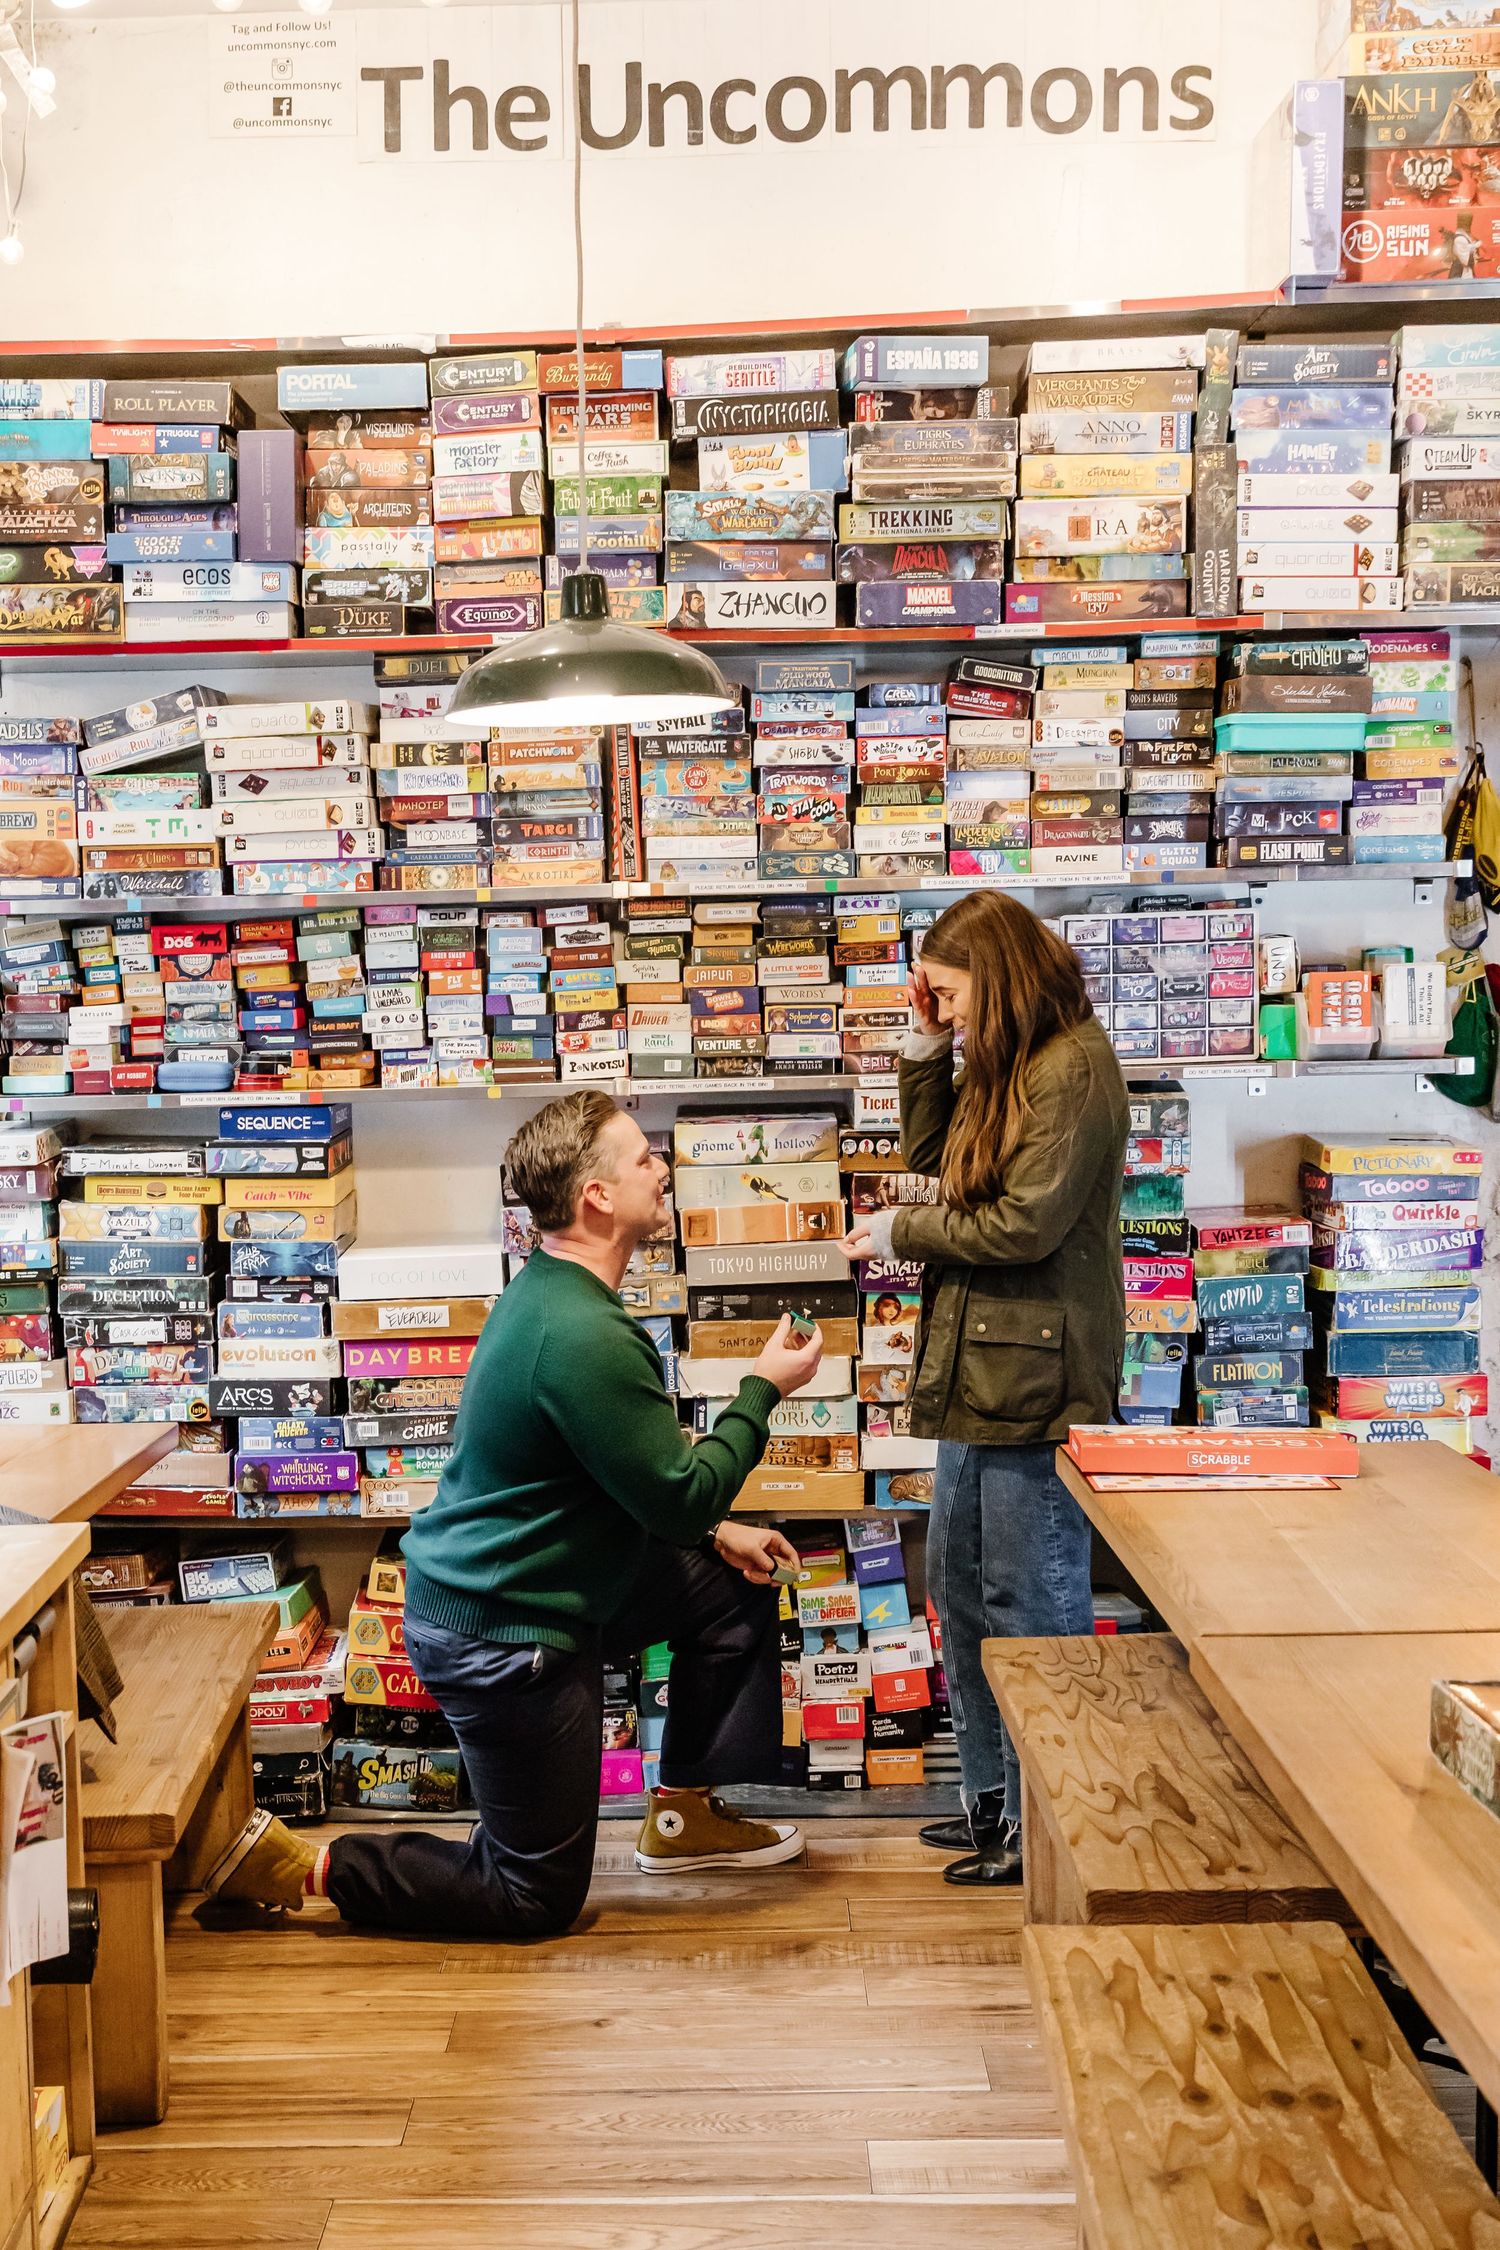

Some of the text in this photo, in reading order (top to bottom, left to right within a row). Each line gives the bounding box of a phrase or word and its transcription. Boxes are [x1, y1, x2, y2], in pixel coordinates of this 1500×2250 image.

[232, 21, 331, 35] Tag and Follow Us!
[228, 38, 337, 52] uncommonsnyc.com
[223, 80, 342, 93] @theuncommonsnyc
[360, 58, 1214, 153] The Uncommons
[1351, 83, 1436, 114] ANKH
[233, 117, 332, 129] @uncommonsnyc
[1403, 156, 1452, 176] blood
[1408, 174, 1448, 191] rage
[1387, 224, 1429, 238] RISING
[1387, 240, 1429, 257] SUN
[886, 347, 979, 370] ESPAÑA 1936
[1306, 347, 1330, 364] ART
[728, 363, 772, 371] REBUILDING
[1294, 362, 1339, 382] SOCIETY
[287, 374, 357, 390] PORTAL
[445, 364, 512, 386] CENTURY
[725, 371, 777, 388] SEATTLE
[1036, 378, 1119, 393] MERCHANTS
[114, 398, 218, 412] ROLL PLAYER
[1047, 391, 1135, 408] MARAUDERS
[457, 399, 515, 421] CENTURY
[112, 428, 199, 438] TWILIGHT STRUGGLE
[365, 423, 414, 435] VISCOUNTS
[1082, 420, 1141, 433] ANNO
[917, 429, 952, 441] TIGRIS
[1094, 435, 1129, 444] 1800
[450, 442, 501, 457] monster
[728, 443, 776, 460] Funny
[904, 439, 964, 451] EUPHRATES
[588, 452, 612, 461] Coffee
[1287, 444, 1337, 461] HAMLET
[1425, 444, 1477, 471] STEAM UP
[358, 461, 407, 475] PALADINS
[454, 453, 498, 469] factory
[607, 456, 628, 467] Rush
[733, 454, 783, 472] Bunny
[363, 503, 411, 516] ARCHITECTS
[869, 508, 953, 527] TREKKING
[341, 541, 398, 553] passtally
[183, 568, 231, 585] ecos
[1205, 550, 1215, 604] COUNTY
[1218, 549, 1229, 606] HARROW
[907, 587, 952, 604] MARVEL
[717, 591, 827, 618] ZHANGUO
[902, 606, 956, 615] CHAMPIONS
[337, 609, 390, 627] DUKE
[463, 608, 516, 621] Equinox
[408, 661, 447, 674] DUEL
[974, 665, 1023, 682] GOODCRITTERS
[775, 679, 835, 689] MANCALA
[951, 693, 1008, 709] RESISTANCE
[971, 691, 991, 699] THE
[768, 701, 836, 713] SKY TEAM
[657, 714, 706, 731] SPYFALL
[1158, 717, 1179, 731] CITY
[1056, 726, 1105, 739] DECRYPTO
[509, 745, 574, 757] PATCHWORK
[667, 740, 727, 754] WATERGATE
[874, 766, 930, 779] PORT ROYAL
[767, 773, 826, 788] TRAPWORDS
[398, 800, 444, 812] IMHOTEP
[792, 800, 815, 818] STAY
[809, 802, 837, 820] COOL
[521, 823, 573, 837] TARGI
[529, 846, 570, 857] CORINTH
[1160, 847, 1199, 856] GLITCH
[1260, 841, 1325, 862] FLASH POINT
[1360, 845, 1409, 855] CODENAMES
[1055, 853, 1098, 863] RAVINE
[1162, 856, 1196, 865] SQUAD
[521, 870, 575, 881] AKROTIRI
[851, 900, 882, 909] CAT
[429, 911, 467, 921] COUP
[1271, 946, 1287, 982] UNO
[693, 970, 733, 983] JAIPUR
[780, 989, 826, 999] WORDSY
[312, 1022, 359, 1031] SOLAR DRAFT
[697, 1040, 741, 1051] VENTURE
[237, 1116, 311, 1130] SEQUENCE
[692, 1138, 816, 1157] gnome hollow
[1353, 1156, 1433, 1172] PICTIONARY
[1359, 1178, 1430, 1198] Taboo
[245, 1190, 312, 1201] Catch Vibe
[1393, 1204, 1460, 1221] Qwirkle
[116, 1219, 143, 1227] AZUL
[708, 1253, 828, 1274] TOKYO HIGHWAY
[92, 1290, 175, 1302] DECEPTION
[1361, 1298, 1461, 1314] Telestrations
[222, 1345, 316, 1362] evolution
[666, 1356, 674, 1391] KOSMOS
[1212, 1362, 1283, 1382] FLATIRON
[1388, 1381, 1423, 1396] WITS
[217, 1386, 273, 1407] ARCS
[1384, 1393, 1445, 1407] WAGERS
[402, 1421, 448, 1440] CRIME
[1191, 1455, 1250, 1465] SCRABBLE
[281, 1461, 324, 1474] WHIRLING
[272, 1474, 332, 1487] WITCHCRAFT
[817, 1664, 855, 1675] Poetry
[815, 1677, 858, 1685] NEANDERTHALS
[872, 1718, 892, 1726] Cards
[873, 1724, 897, 1732] Against
[874, 1729, 905, 1738] Humanity
[358, 1756, 433, 1790] SMASH UP
